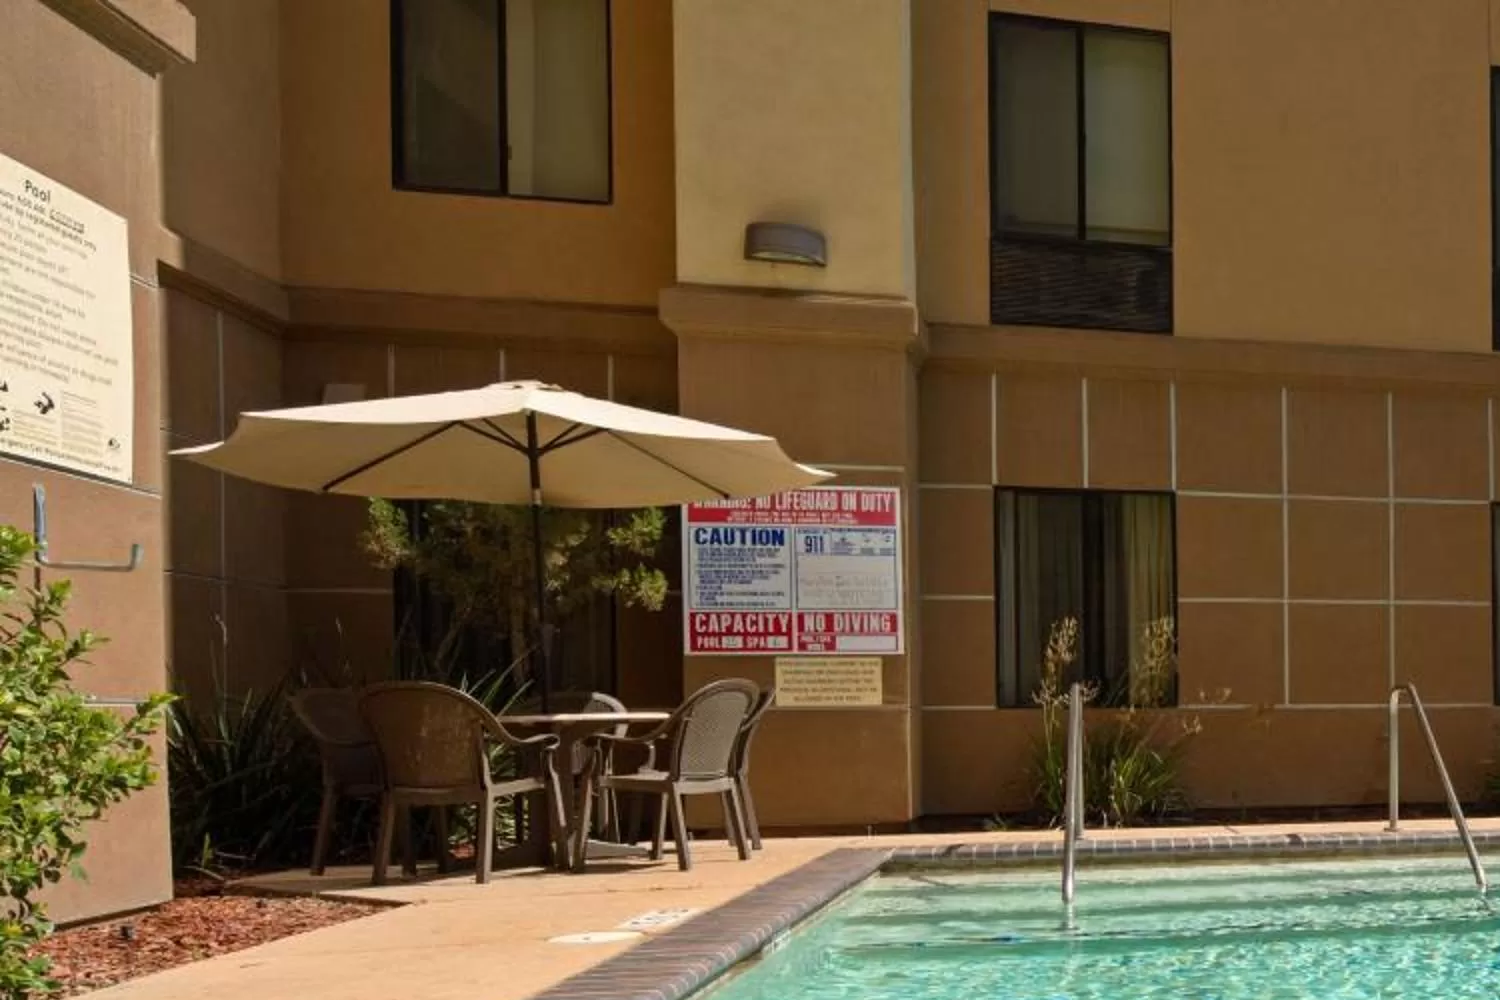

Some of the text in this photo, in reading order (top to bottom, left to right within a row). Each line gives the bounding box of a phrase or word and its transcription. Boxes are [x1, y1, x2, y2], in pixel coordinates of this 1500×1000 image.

[25, 179, 51, 203] Pool
[775, 491, 837, 510] LIFEGUARD
[842, 491, 857, 511] ON
[861, 493, 891, 513] DUTY
[694, 527, 785, 547] CAUTION
[804, 535, 824, 554] 911
[695, 613, 789, 633] CAPACITY
[804, 612, 891, 633] NO DIVING
[698, 636, 722, 648] POOL
[747, 636, 767, 649] SPA
